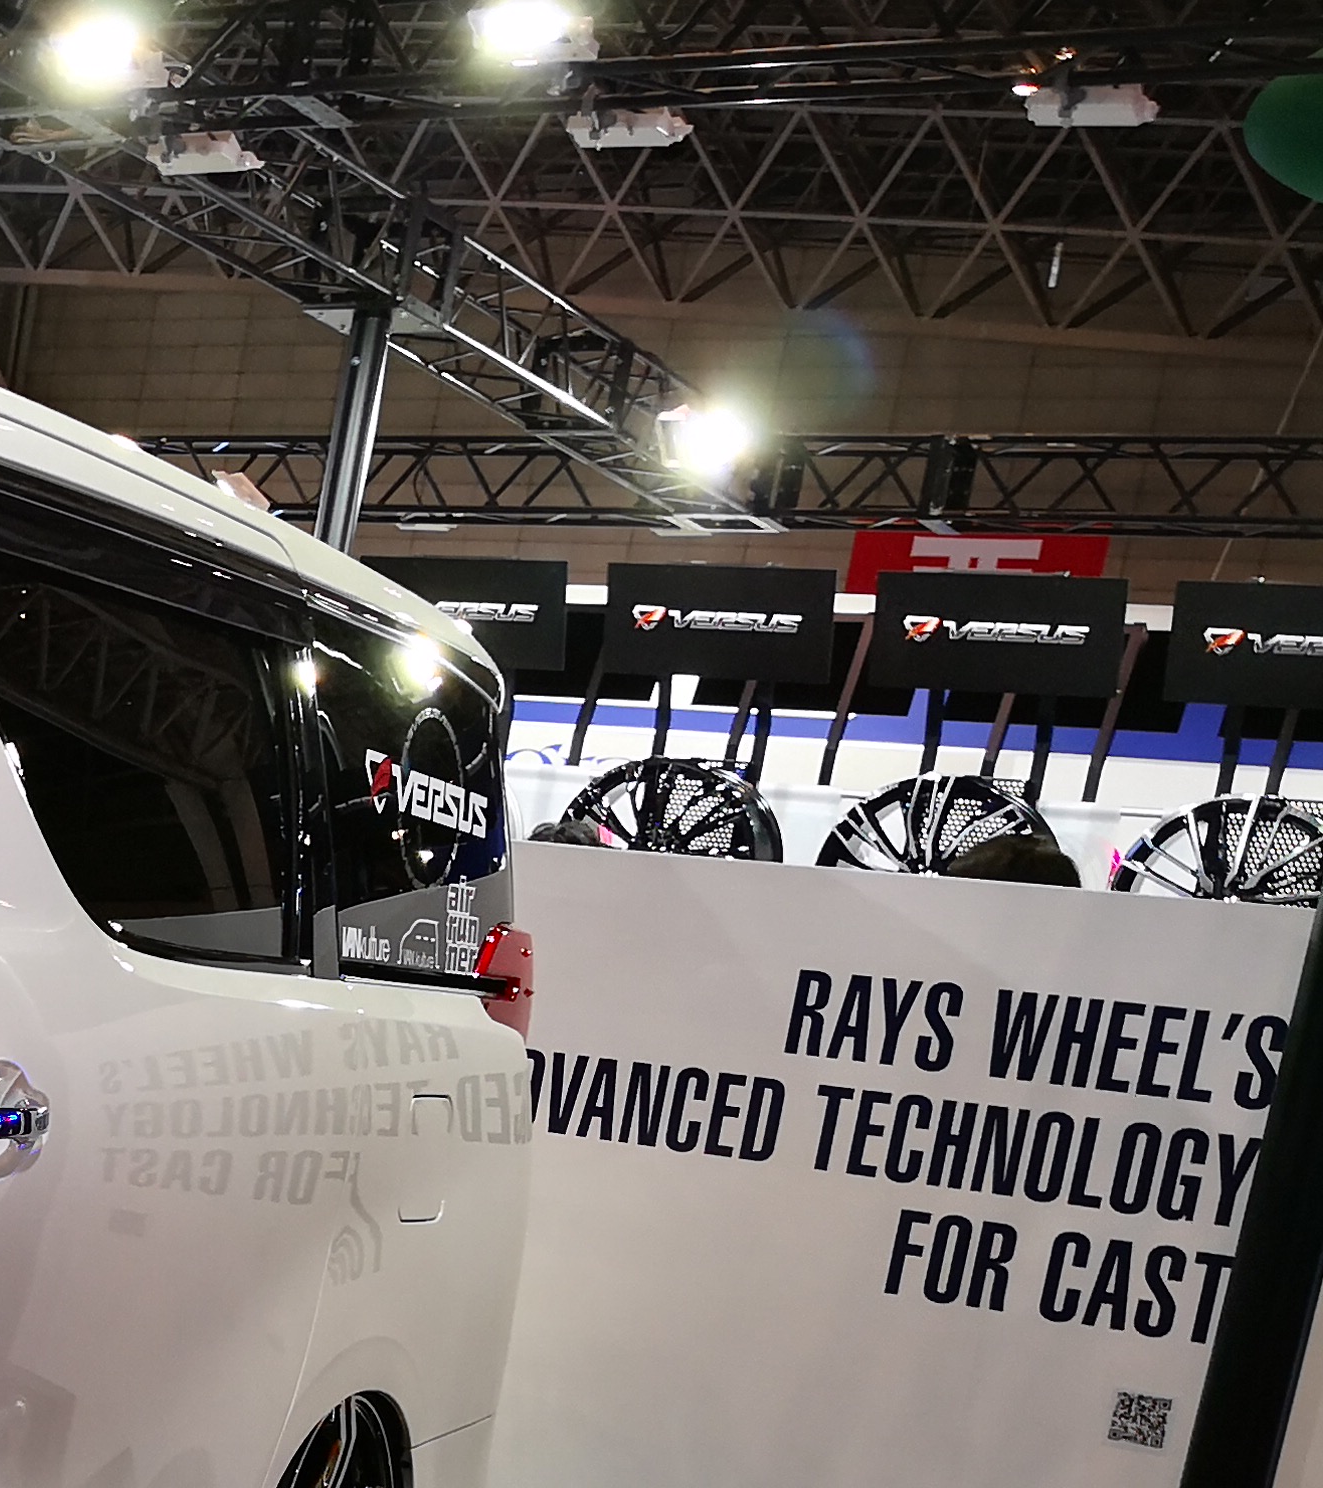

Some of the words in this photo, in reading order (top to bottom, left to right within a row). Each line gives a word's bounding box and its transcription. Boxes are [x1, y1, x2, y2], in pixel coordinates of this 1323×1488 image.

[435, 600, 539, 623] ERSUS
[668, 609, 803, 634] VERSUS
[943, 619, 1090, 646] VERSUS
[392, 763, 488, 839] VERSUS
[784, 968, 964, 1073] RAYS
[988, 988, 1290, 1110] WHEEL'S
[525, 1047, 786, 1162] DVANCED
[813, 1084, 1264, 1227] TECHNOLOGY
[884, 1208, 1017, 1313] FOR
[1039, 1230, 1237, 1345] CAST
